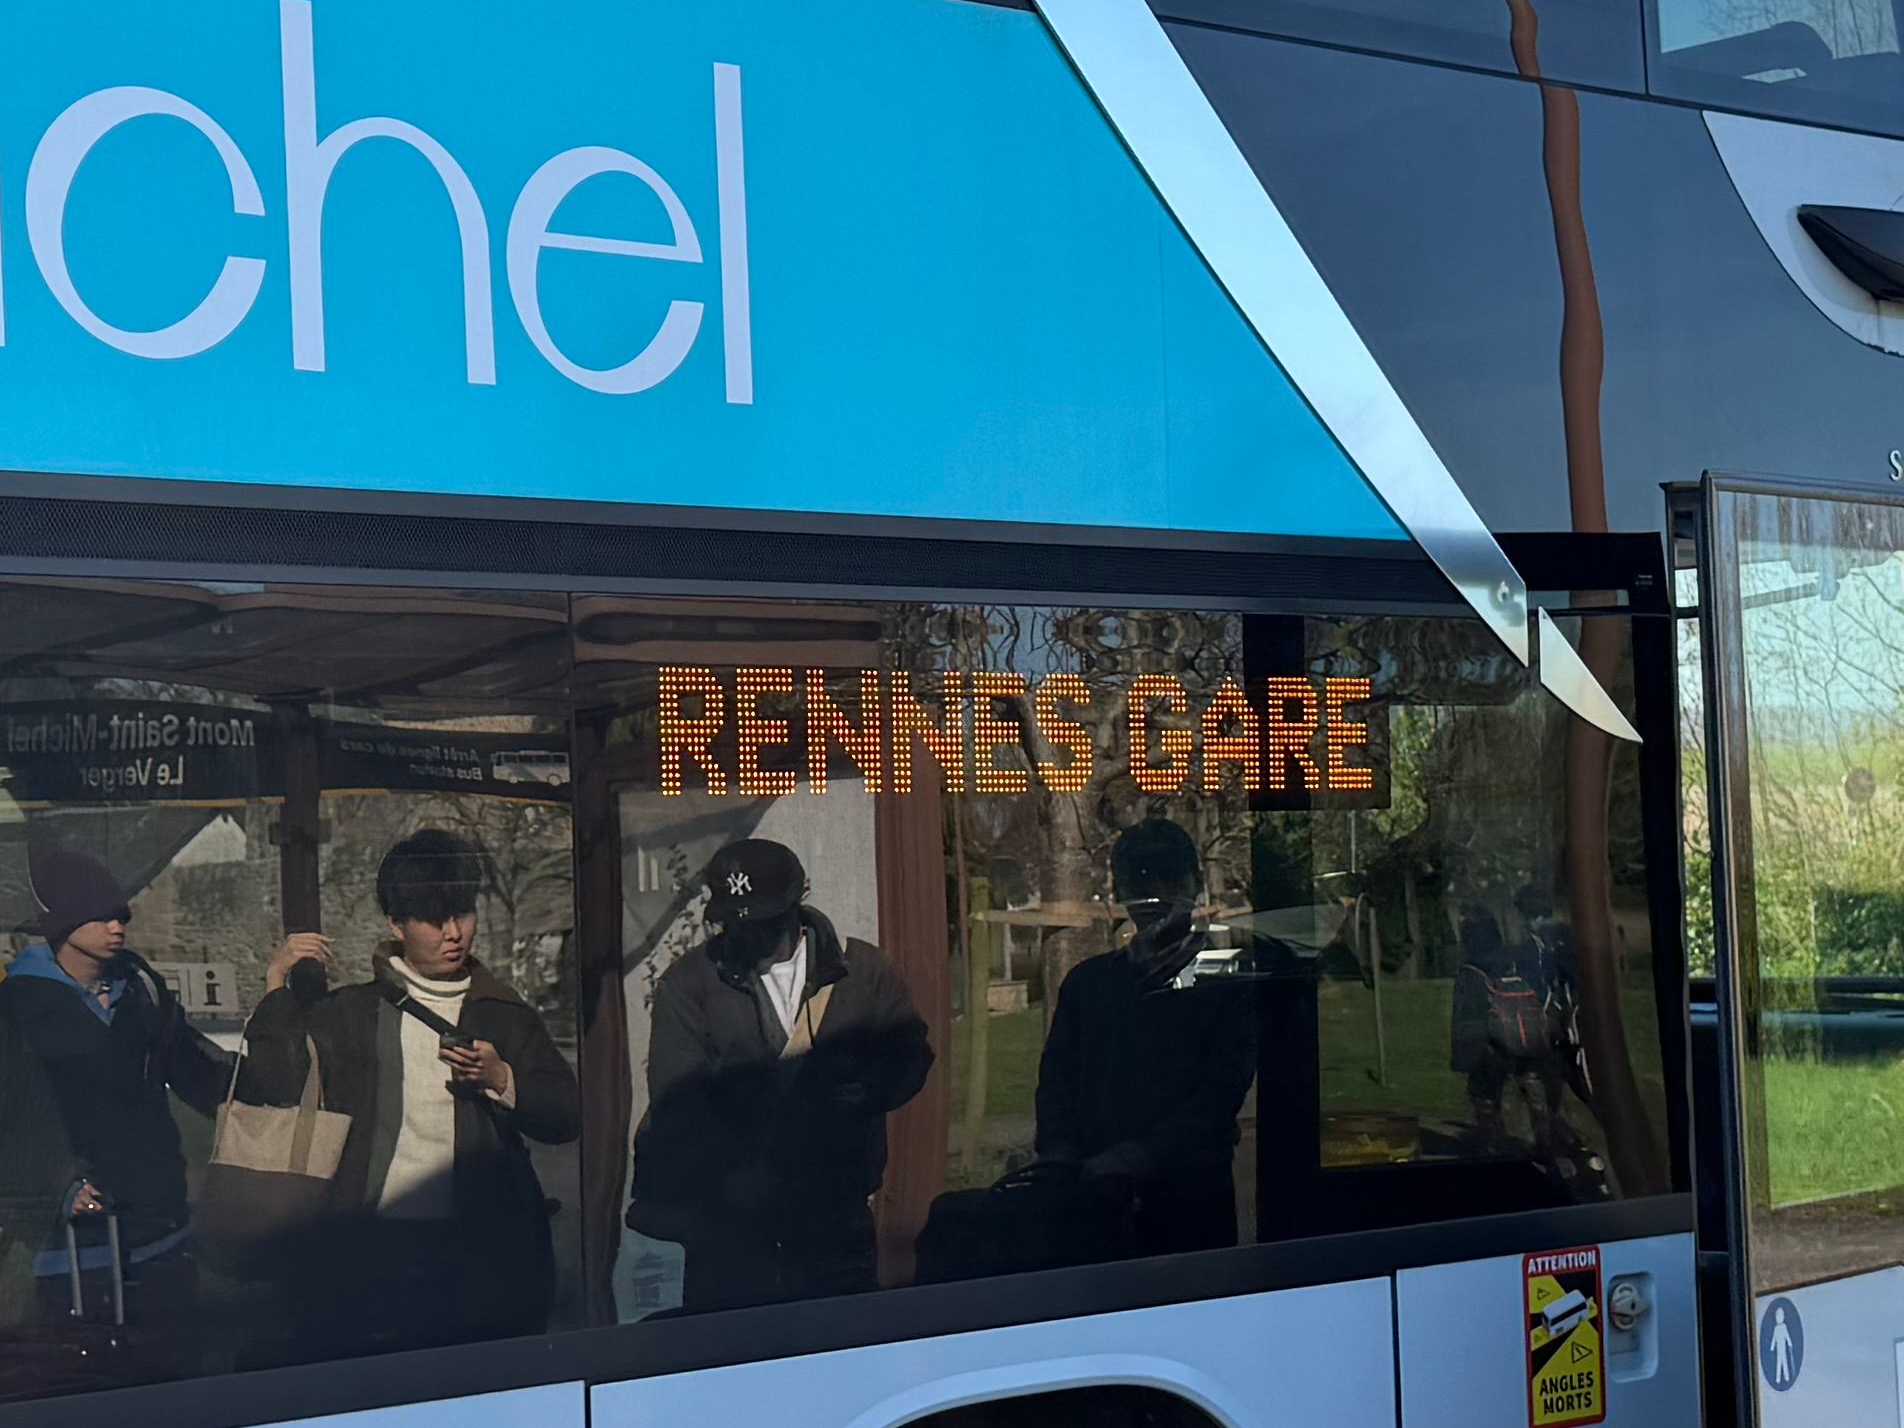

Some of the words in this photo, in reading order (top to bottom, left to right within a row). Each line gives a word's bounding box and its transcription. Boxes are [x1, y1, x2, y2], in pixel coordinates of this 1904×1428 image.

[1890, 449, 1903, 482] S
[659, 666, 1094, 796] RENNES
[1127, 673, 1375, 792] GARE
[1527, 1249, 1597, 1275] ATTENTION
[1539, 1371, 1595, 1397] ANGLES
[1543, 1391, 1593, 1416] MORTS
